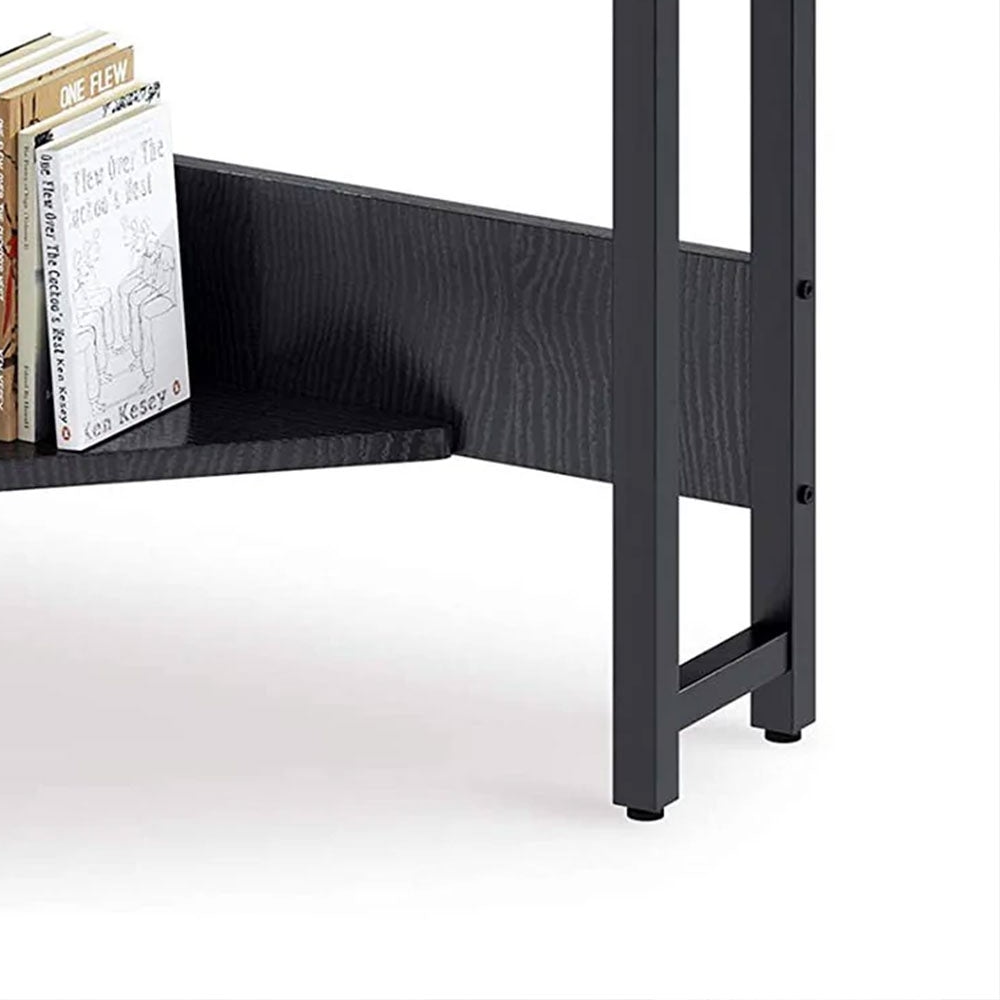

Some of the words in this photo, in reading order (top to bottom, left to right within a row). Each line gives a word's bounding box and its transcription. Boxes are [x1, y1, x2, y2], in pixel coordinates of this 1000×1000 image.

[60, 83, 86, 108] ONE
[89, 59, 128, 93] FLEW
[40, 154, 53, 176] One
[141, 137, 165, 165] The
[42, 180, 55, 209] Flew
[44, 212, 57, 241] Over
[47, 245, 60, 266] The
[53, 327, 65, 354] Nest
[56, 358, 65, 382] Ken
[58, 386, 68, 424] Kesey
[84, 420, 112, 440] Ken
[118, 389, 167, 426] Kesey
